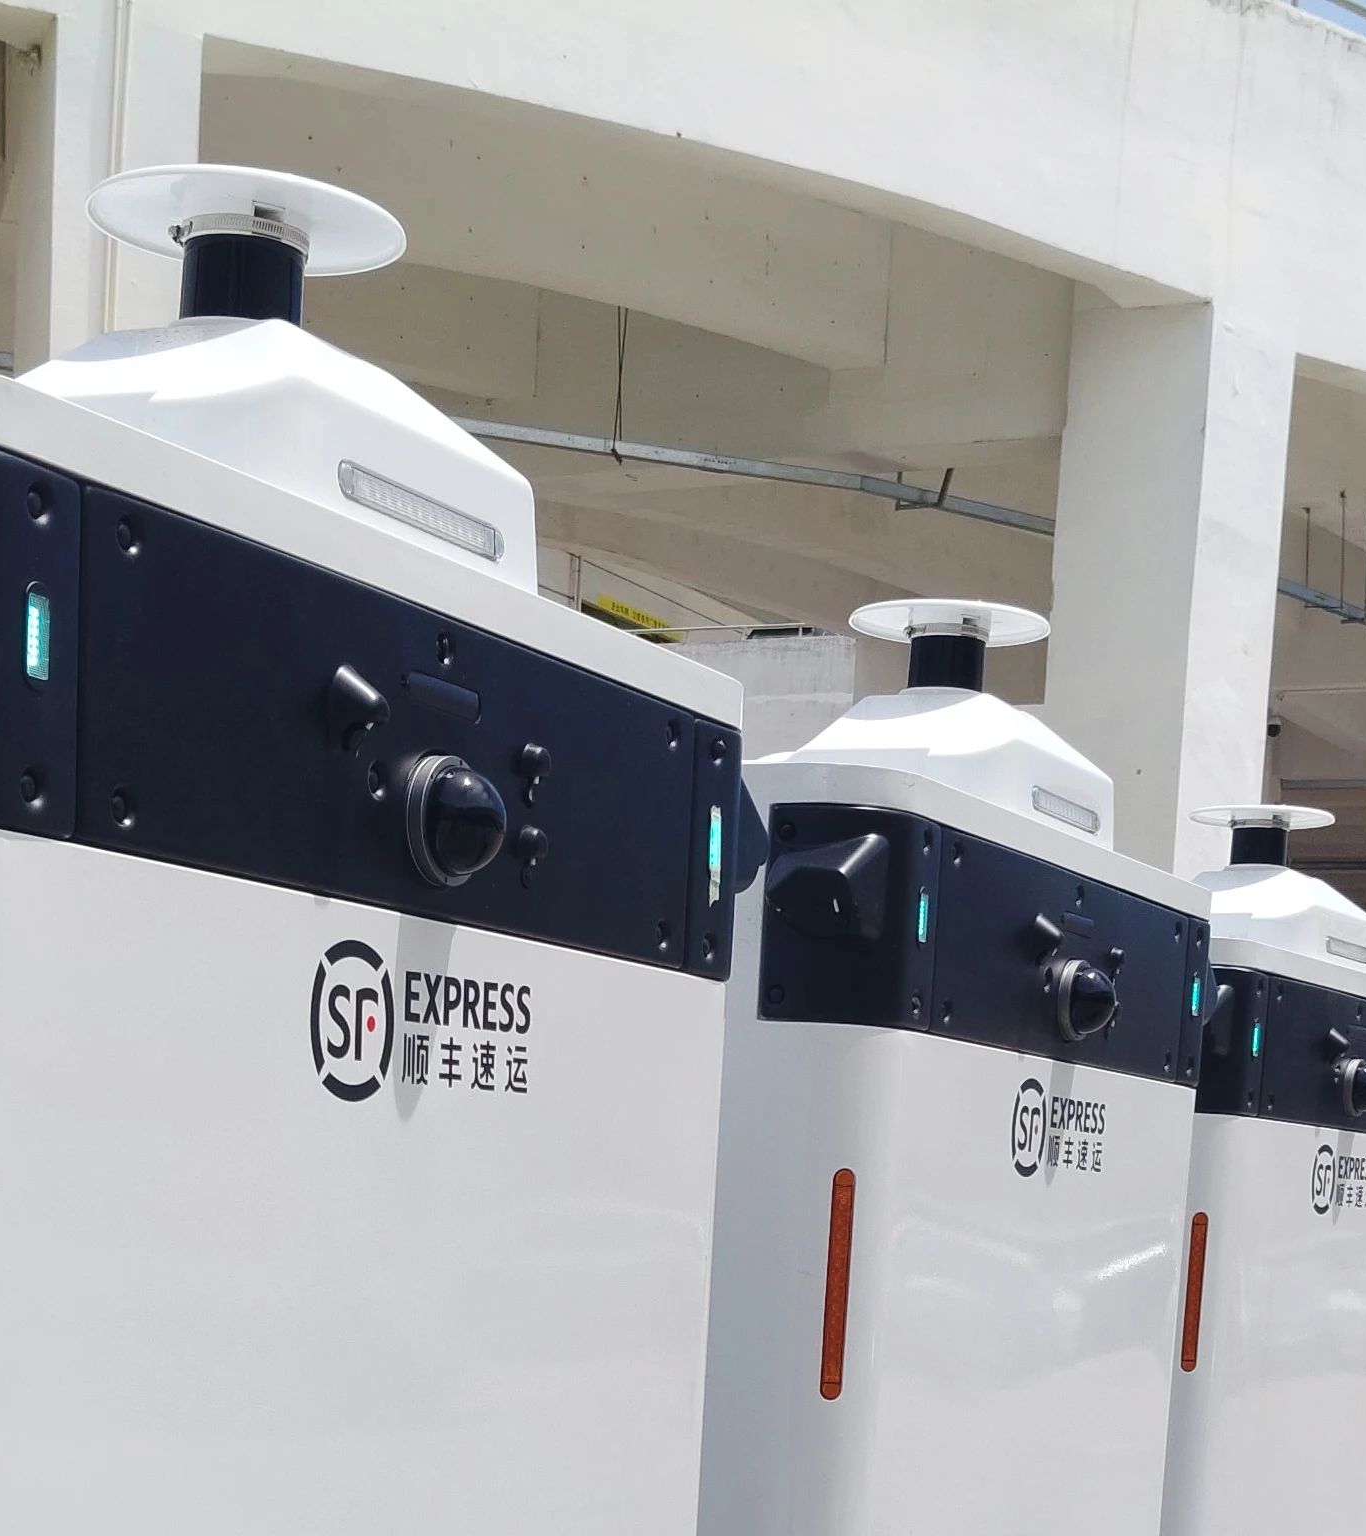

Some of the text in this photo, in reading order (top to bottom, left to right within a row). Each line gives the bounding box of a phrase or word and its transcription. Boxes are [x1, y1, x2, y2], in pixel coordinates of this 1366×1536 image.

[404, 971, 531, 1035] EXPRESS
[402, 1033, 529, 1094] 顺丰速运
[1050, 1096, 1106, 1135] EXPRESS
